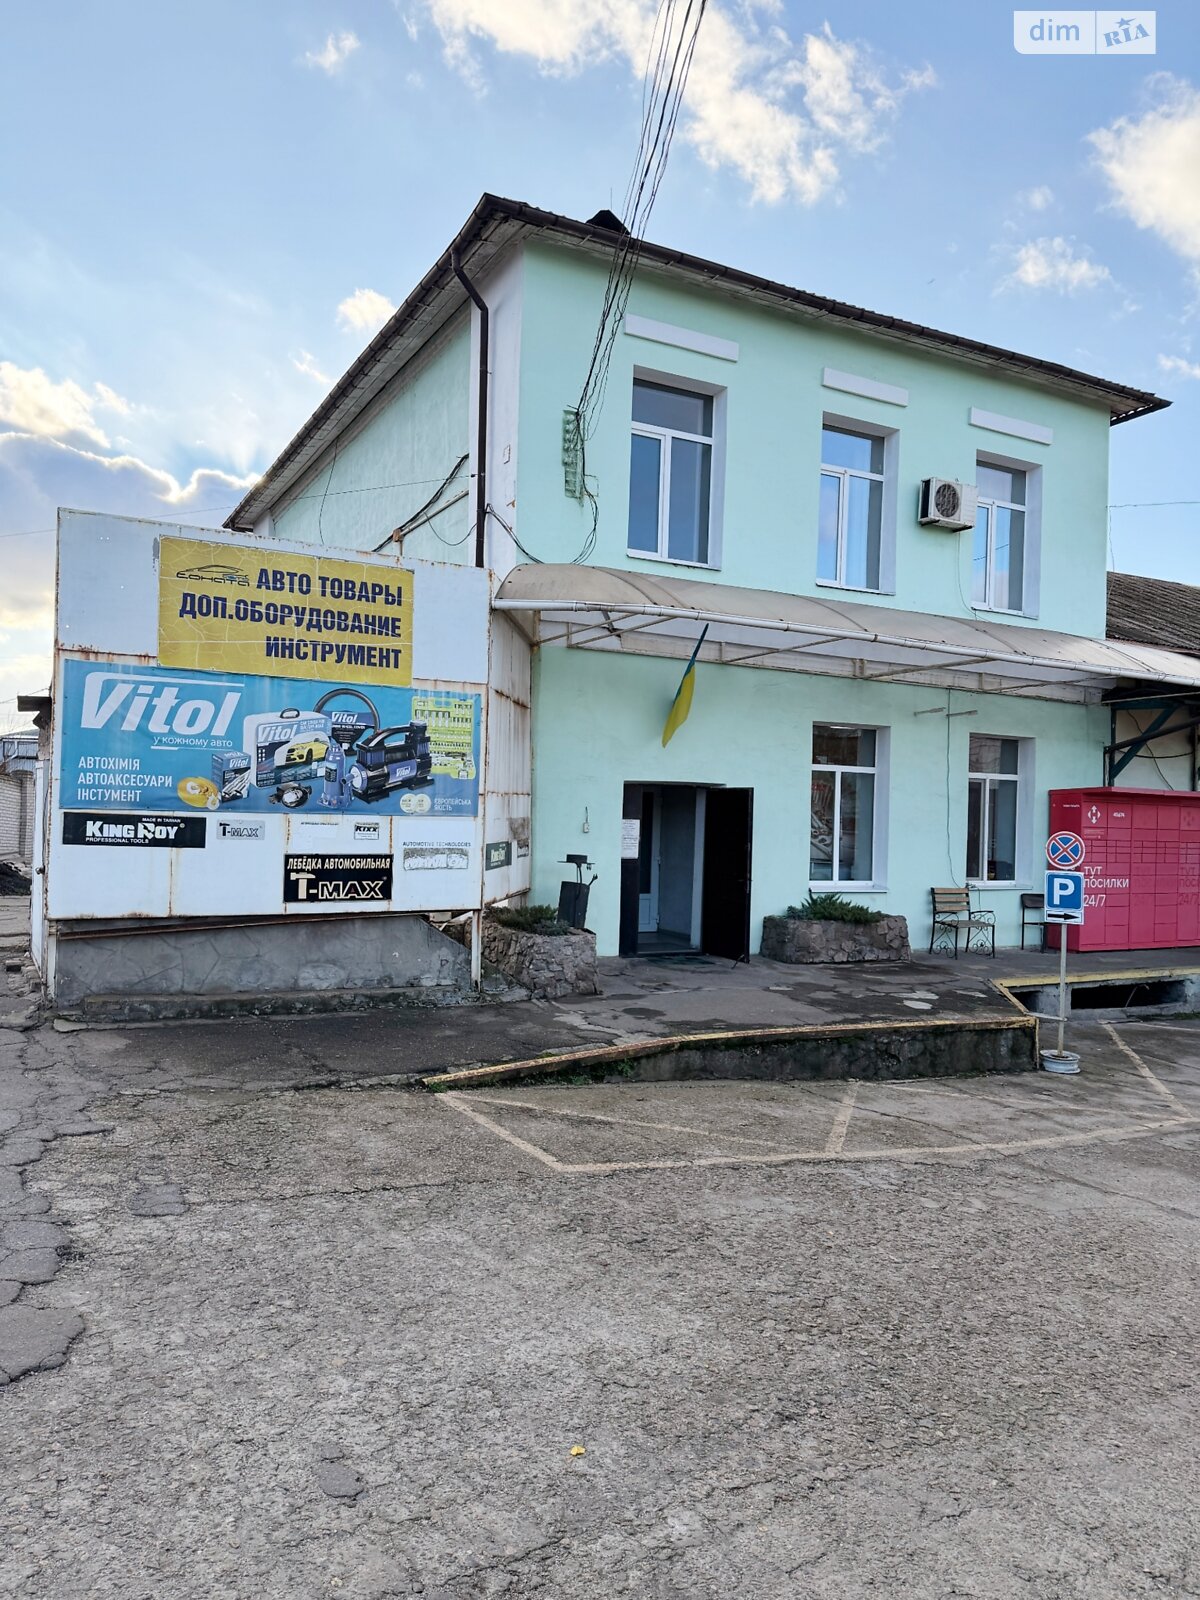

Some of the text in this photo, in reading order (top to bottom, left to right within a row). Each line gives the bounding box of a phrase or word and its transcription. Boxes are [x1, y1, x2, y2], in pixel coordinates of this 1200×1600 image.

[256, 568, 403, 607] АВТО ТОВАРЫ
[179, 592, 402, 638] ДОП.ОБОРУДОВАНИЕ
[265, 636, 402, 669] ИНСТРУМЕНТ
[81, 672, 245, 736] Vitol
[332, 712, 358, 723] Vitol
[258, 723, 297, 742] Vitol
[153, 737, 233, 748] у кожному авто
[79, 756, 140, 771] АВТОХІМІЯ
[78, 773, 173, 788] АВТОАКСЕСУАРИ
[77, 788, 142, 802] ІНСТУМЕНТ
[219, 822, 259, 838] T-MAX
[287, 856, 322, 871] ЛЕБЁДКА
[324, 858, 391, 870] АВТОМОБИЛЬНАЯ
[290, 872, 384, 900] T-MAX
[1053, 878, 1075, 905] P
[1084, 894, 1106, 907] 24/7
